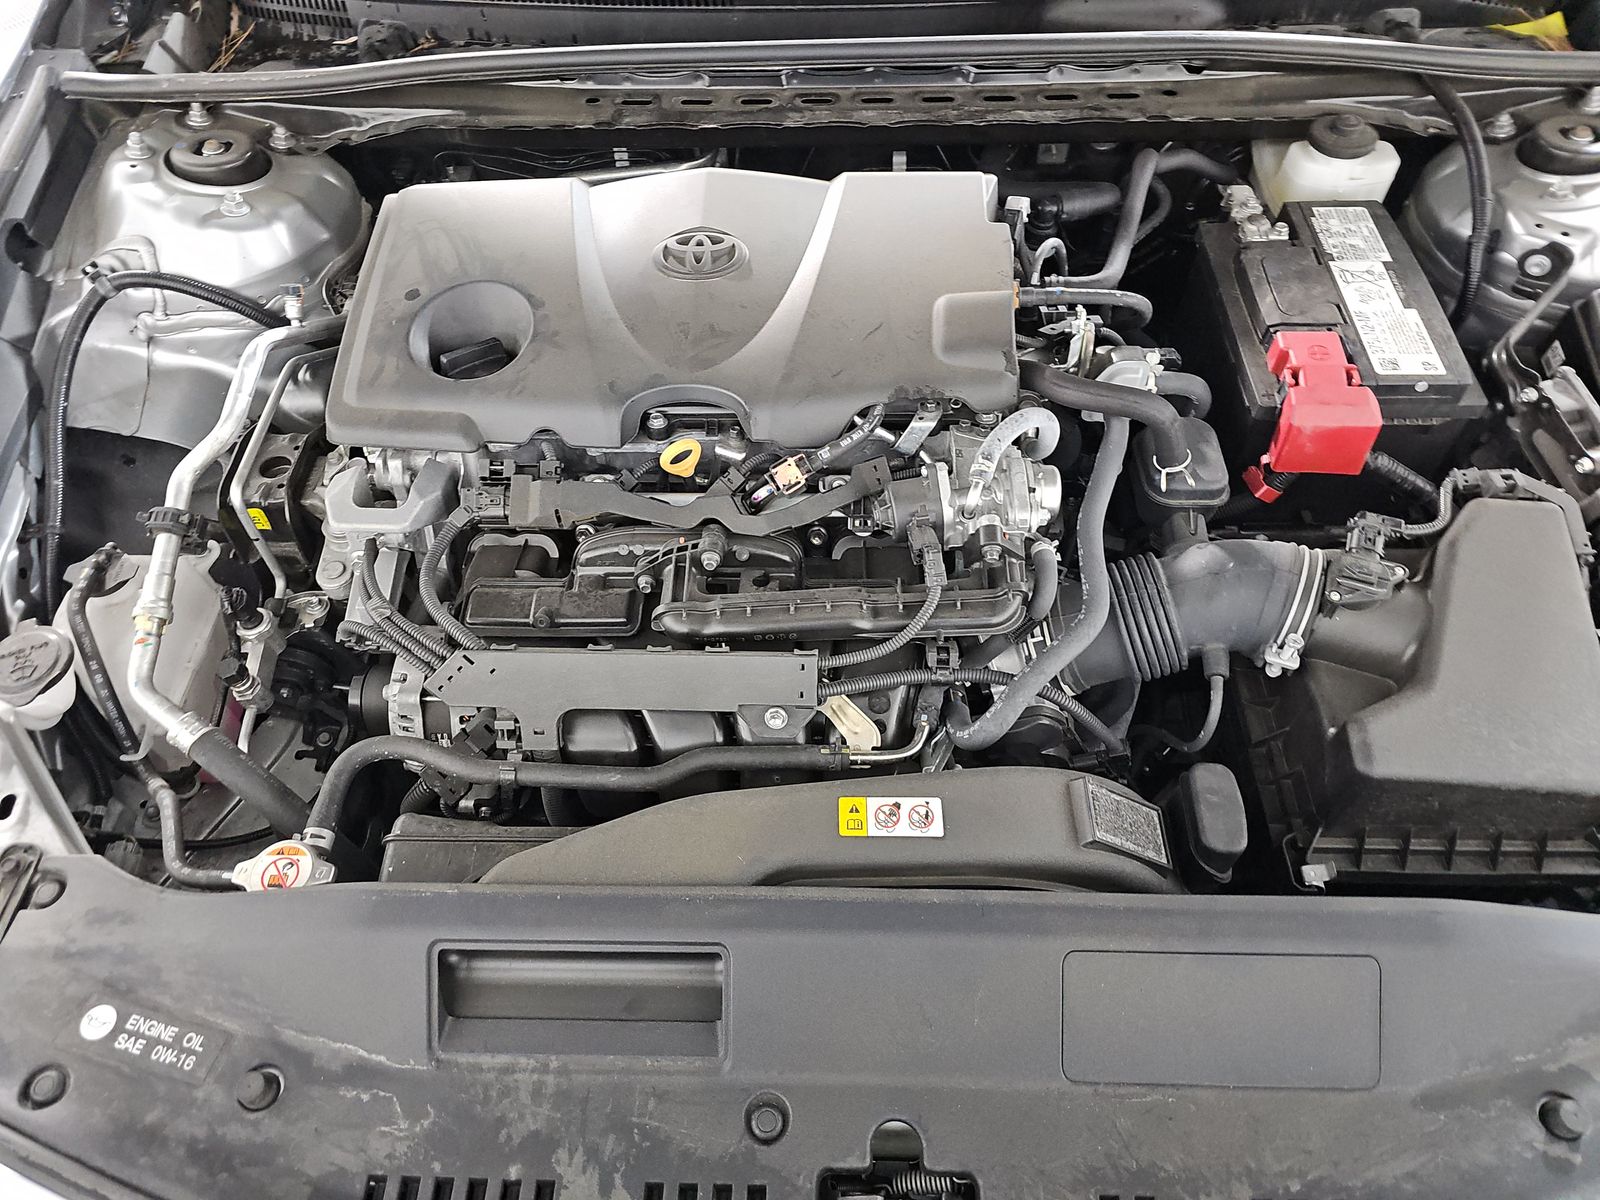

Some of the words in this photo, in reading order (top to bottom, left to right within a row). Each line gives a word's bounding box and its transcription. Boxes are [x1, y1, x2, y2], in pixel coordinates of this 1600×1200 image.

[114, 1033, 146, 1055] SAE
[151, 1045, 196, 1070] 0W-16
[126, 1014, 179, 1042] ENGINE
[183, 1032, 204, 1052] OIL
